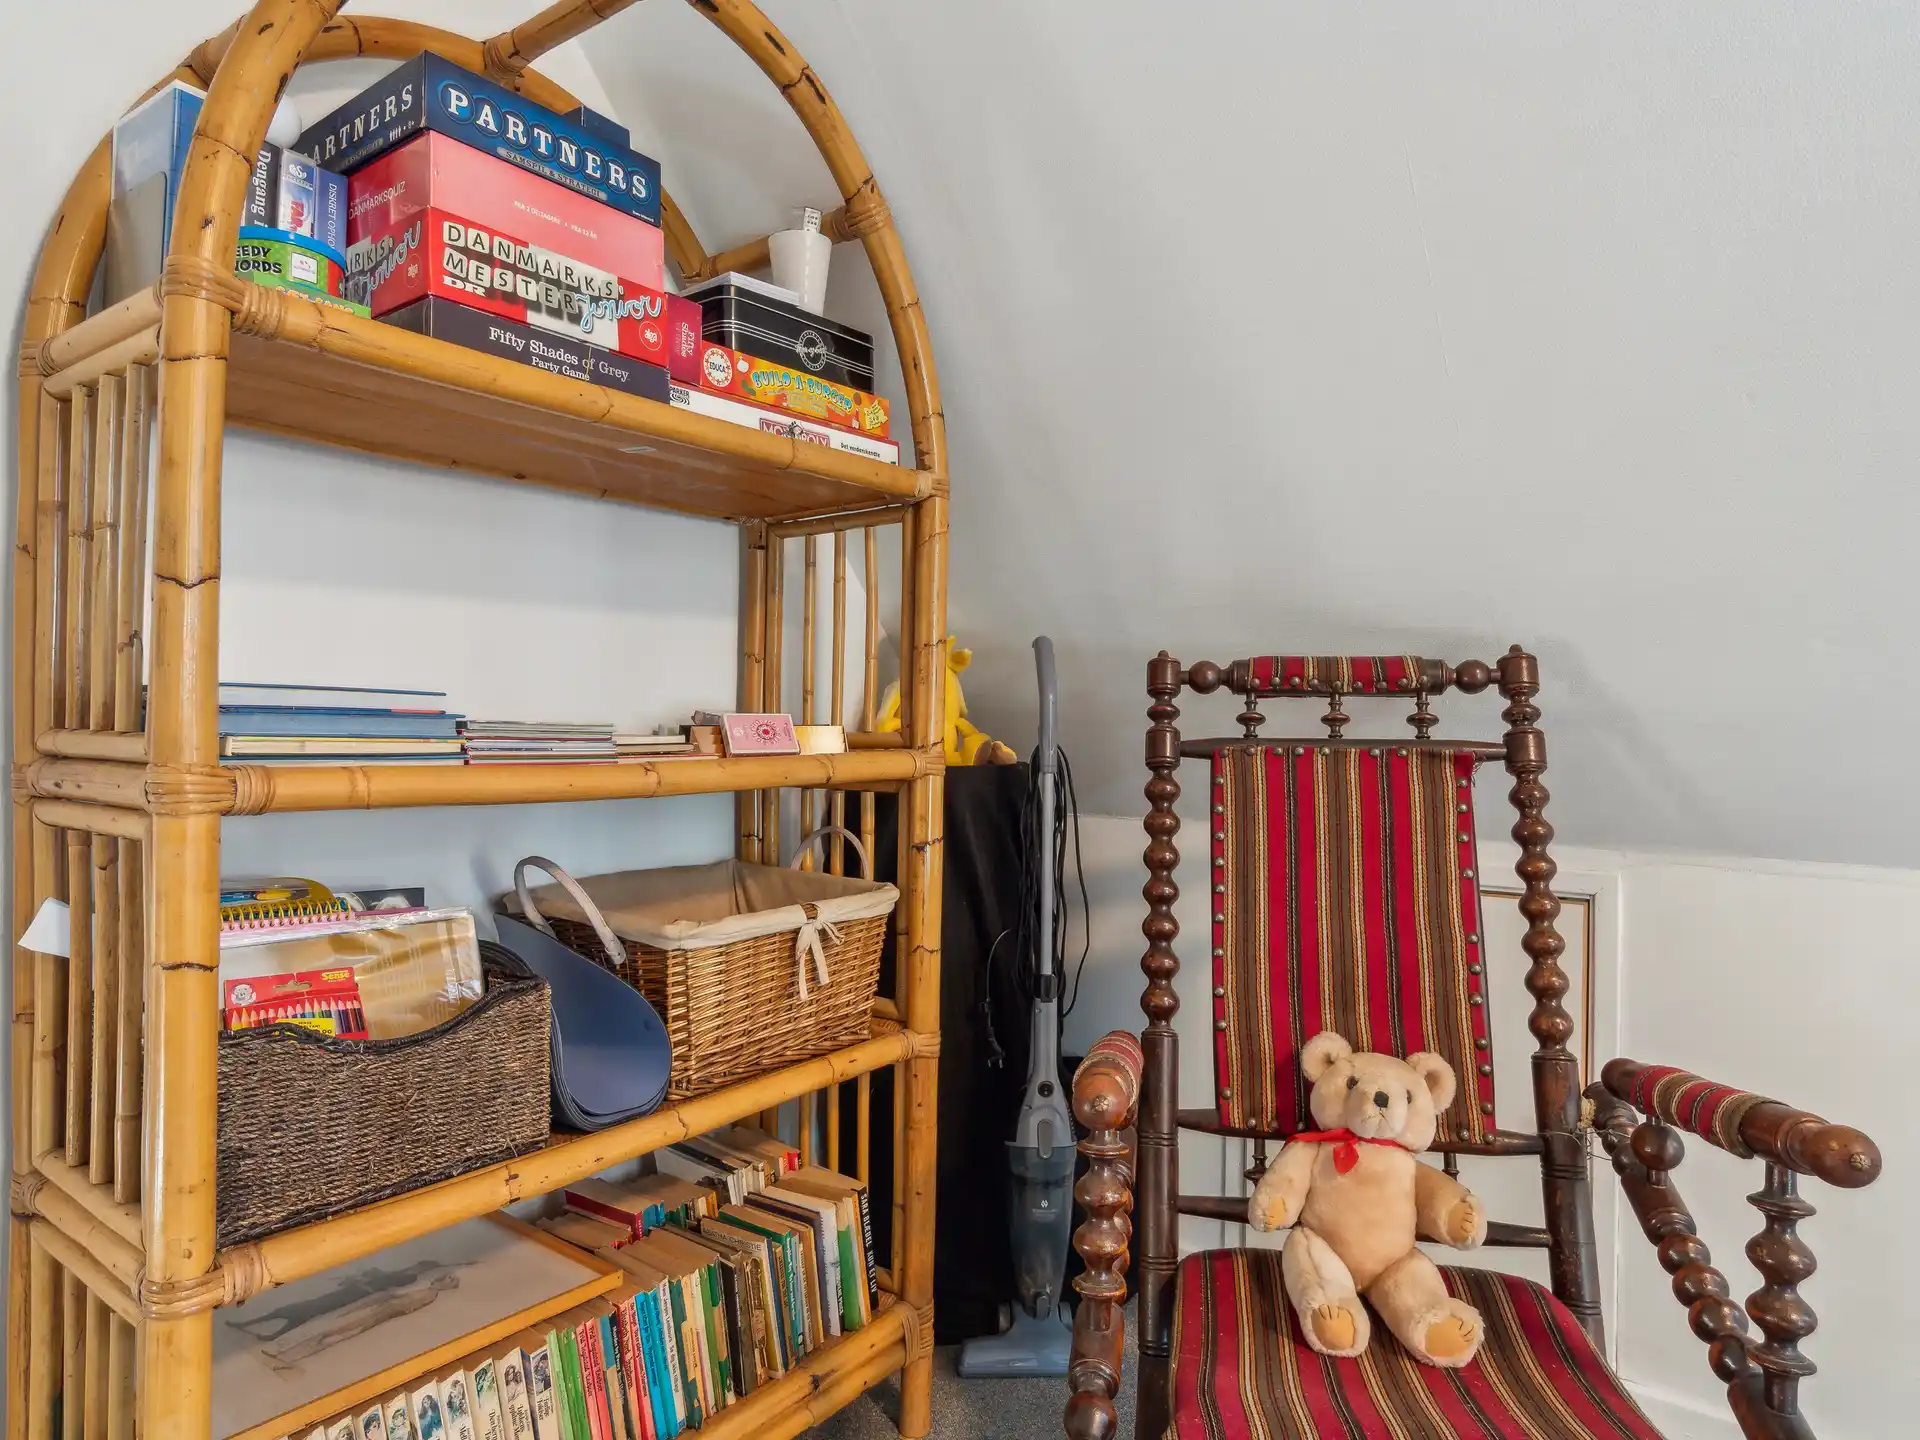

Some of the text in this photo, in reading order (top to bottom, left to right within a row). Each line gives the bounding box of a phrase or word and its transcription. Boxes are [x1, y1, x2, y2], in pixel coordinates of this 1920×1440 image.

[303, 83, 413, 165] ARTNERS
[447, 87, 647, 199] PARTNERS
[251, 150, 272, 217] Dengang
[348, 180, 406, 220] DANMARKSQUIZ
[505, 150, 548, 176] SAMSPIL
[557, 173, 602, 198] STRATEGI
[328, 183, 337, 250] DISKRET OPHO
[235, 260, 282, 275] ORDS
[442, 275, 486, 298] DR
[446, 252, 578, 312] MESTER
[448, 224, 614, 297] DANMARKS
[489, 326, 630, 382] Fifty Shades of Grey
[531, 356, 590, 382] Party Game
[709, 361, 726, 373] EDUCA
[702, 1227, 762, 1251] AGATHA CHRISTIE
[861, 1193, 878, 1293] SARA BLÆDEL KUN ET LIV
